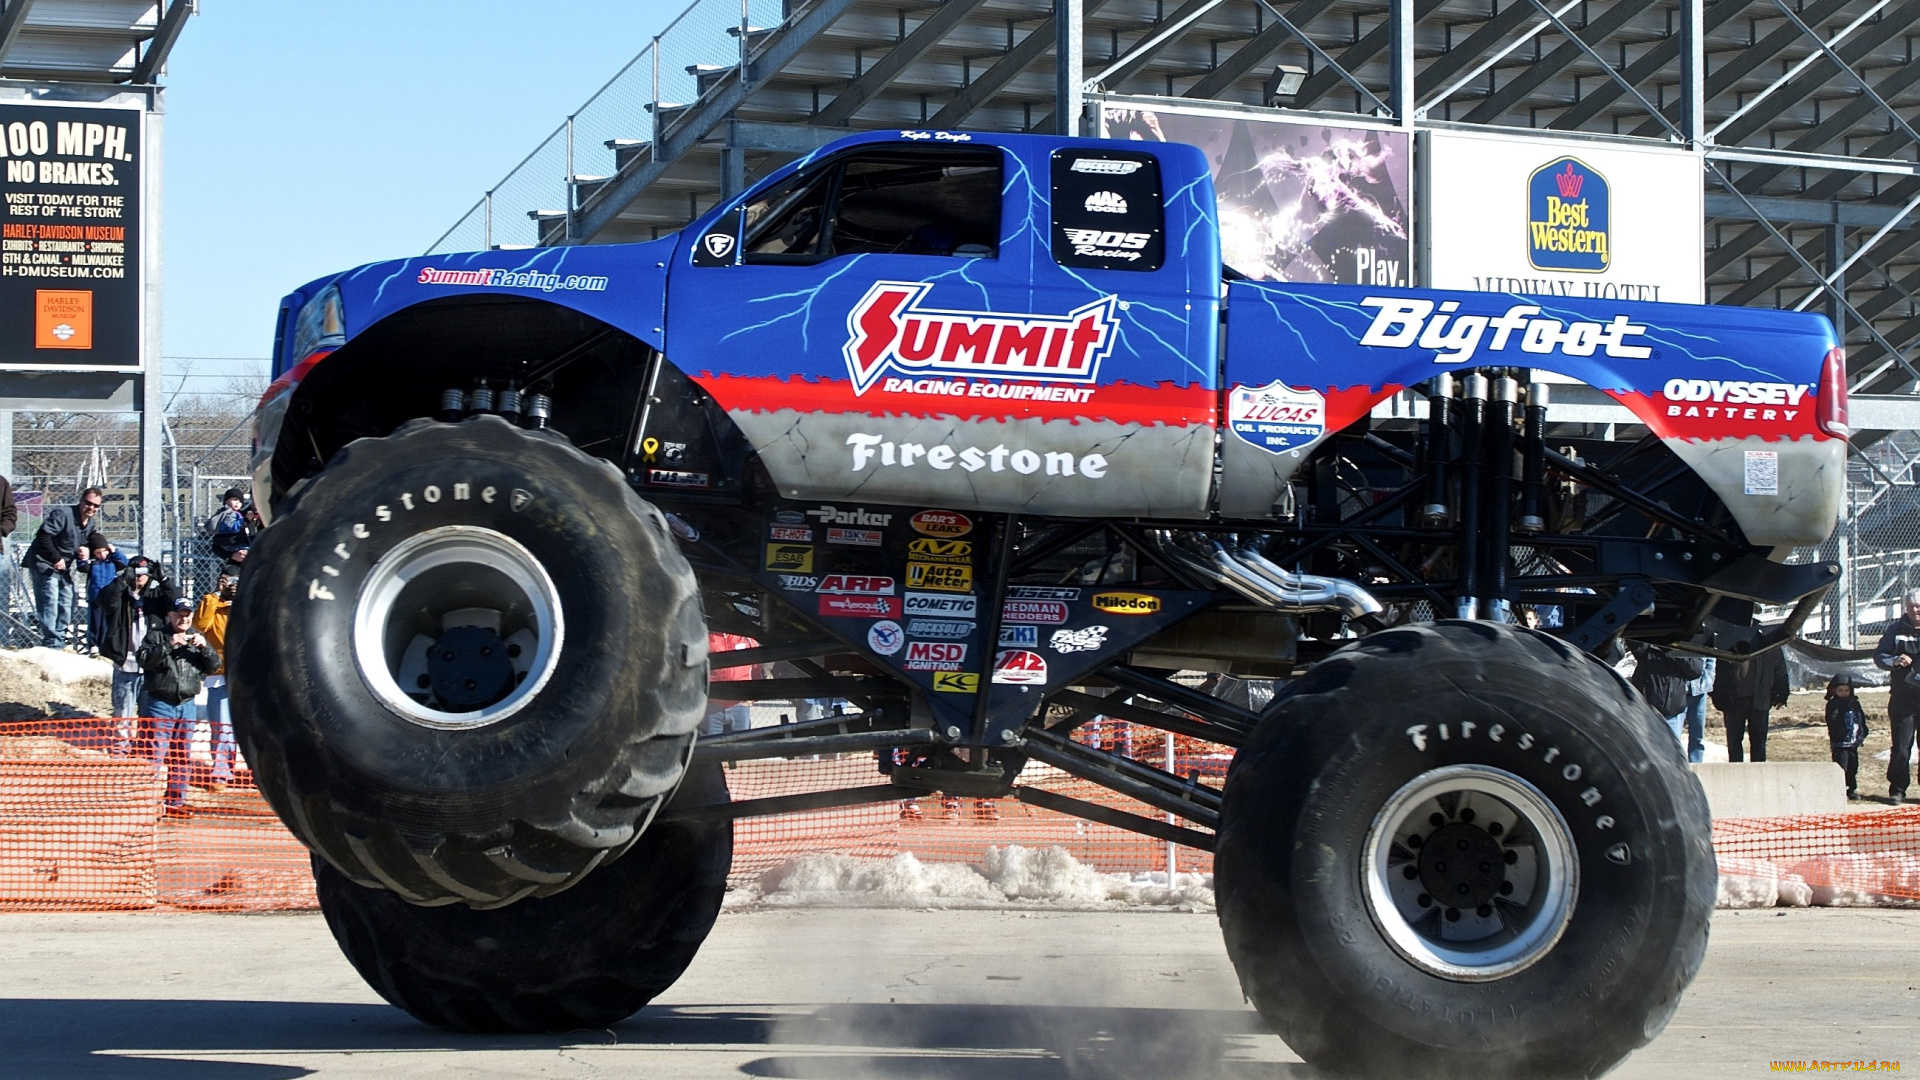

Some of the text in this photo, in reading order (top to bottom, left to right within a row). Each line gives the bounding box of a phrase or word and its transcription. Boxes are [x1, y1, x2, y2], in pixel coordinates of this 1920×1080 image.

[57, 122, 132, 162] MPH.
[8, 160, 118, 185] NO BRAKES.
[6, 193, 124, 207] VISIT TODAY FOR THE
[1084, 191, 1128, 207] MAC
[10, 206, 122, 218] REST OF THE STORY.
[1085, 205, 1128, 214] TOOLS
[1547, 196, 1589, 228] Best
[3, 224, 124, 240] HARLEY-DAVIDSON MUSEUM
[1066, 228, 1151, 249] BDS
[1530, 221, 1608, 254] Western
[3, 241, 124, 254] EXHIBITS RESTAURANTS SHOPPING
[1074, 244, 1142, 261] Racing
[3, 253, 124, 266] 6TH & CANAL MILWAUKEE
[3, 266, 124, 278] H-DMUSEUM.COM
[1357, 248, 1404, 287] Play.
[418, 267, 608, 292] SummitRacing.com
[1359, 297, 1652, 363] Bigfoot
[883, 379, 1095, 403] RACING EQUIPMENT
[1664, 378, 1809, 405] ODYSSEY
[1242, 406, 1317, 422] LUCAS
[1667, 406, 1798, 421] BATTERY
[1236, 424, 1320, 435] OIL PRODUCTS
[1266, 436, 1290, 446] INC.
[846, 432, 1108, 478] Firestone
[814, 505, 892, 526] Parker
[921, 514, 956, 524] BAR'S
[772, 528, 807, 539] JET-HOT
[844, 531, 866, 539] ISKY
[926, 524, 961, 533] LEAKS
[308, 482, 498, 601] Firestone
[776, 553, 804, 563] ESAB
[926, 566, 963, 577] Auto
[783, 575, 818, 587] BDS
[820, 576, 893, 592] ARP
[924, 576, 969, 587] Meter
[906, 598, 975, 611] COMETIC
[1004, 602, 1060, 613] HEDMAN
[1095, 596, 1157, 610] Milodon
[1002, 612, 1060, 621] HEDDERS
[909, 644, 962, 661] MSD
[908, 661, 959, 671] IGNITION
[938, 674, 978, 690] KC
[1406, 720, 1616, 830] Firestone
